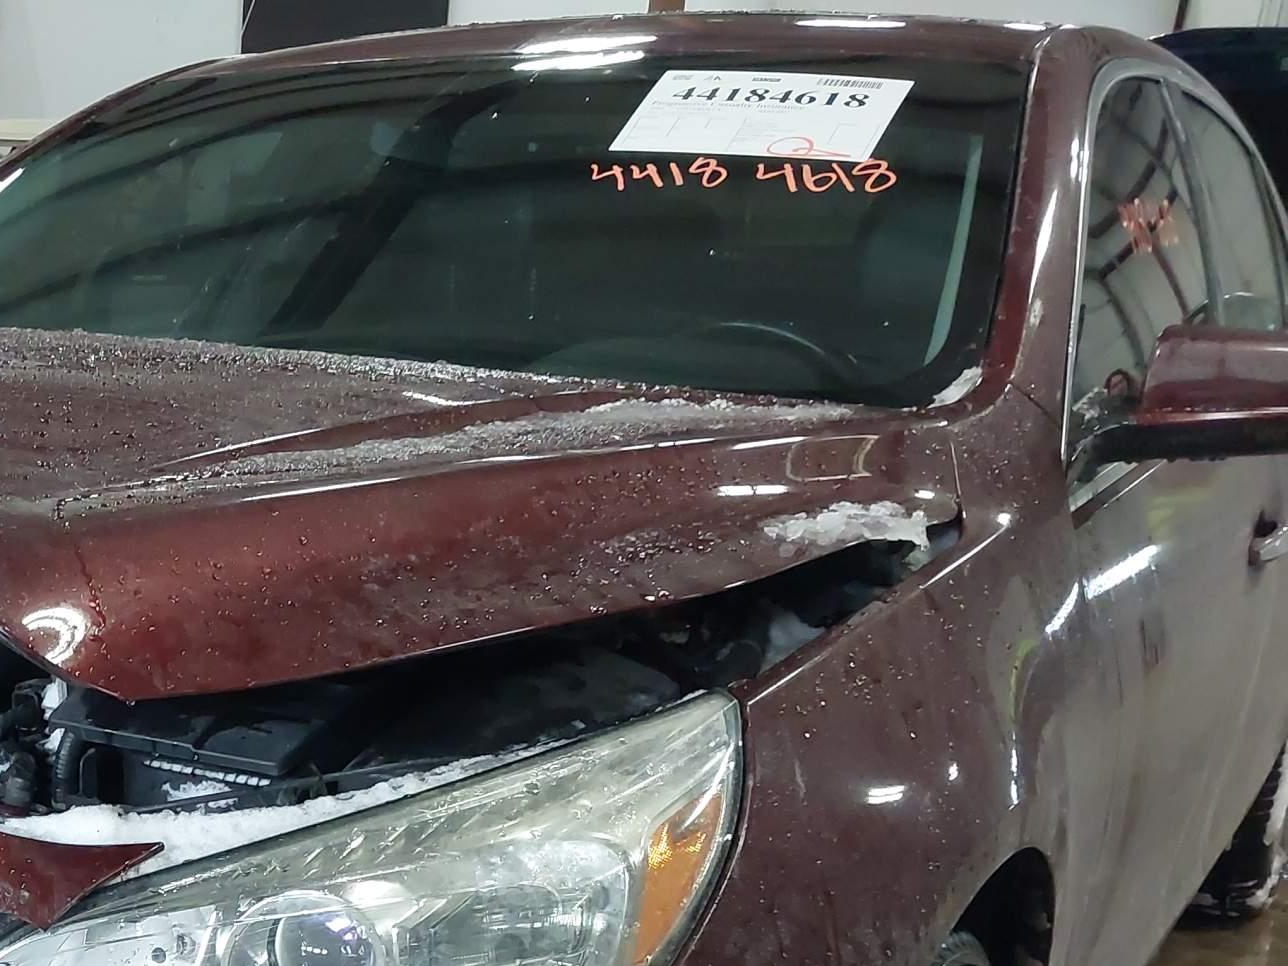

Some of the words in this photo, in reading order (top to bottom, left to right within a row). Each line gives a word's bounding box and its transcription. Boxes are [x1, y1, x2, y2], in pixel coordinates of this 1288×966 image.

[672, 86, 870, 108] 44184618
[590, 157, 728, 191] 4418
[756, 158, 897, 193] 4618
